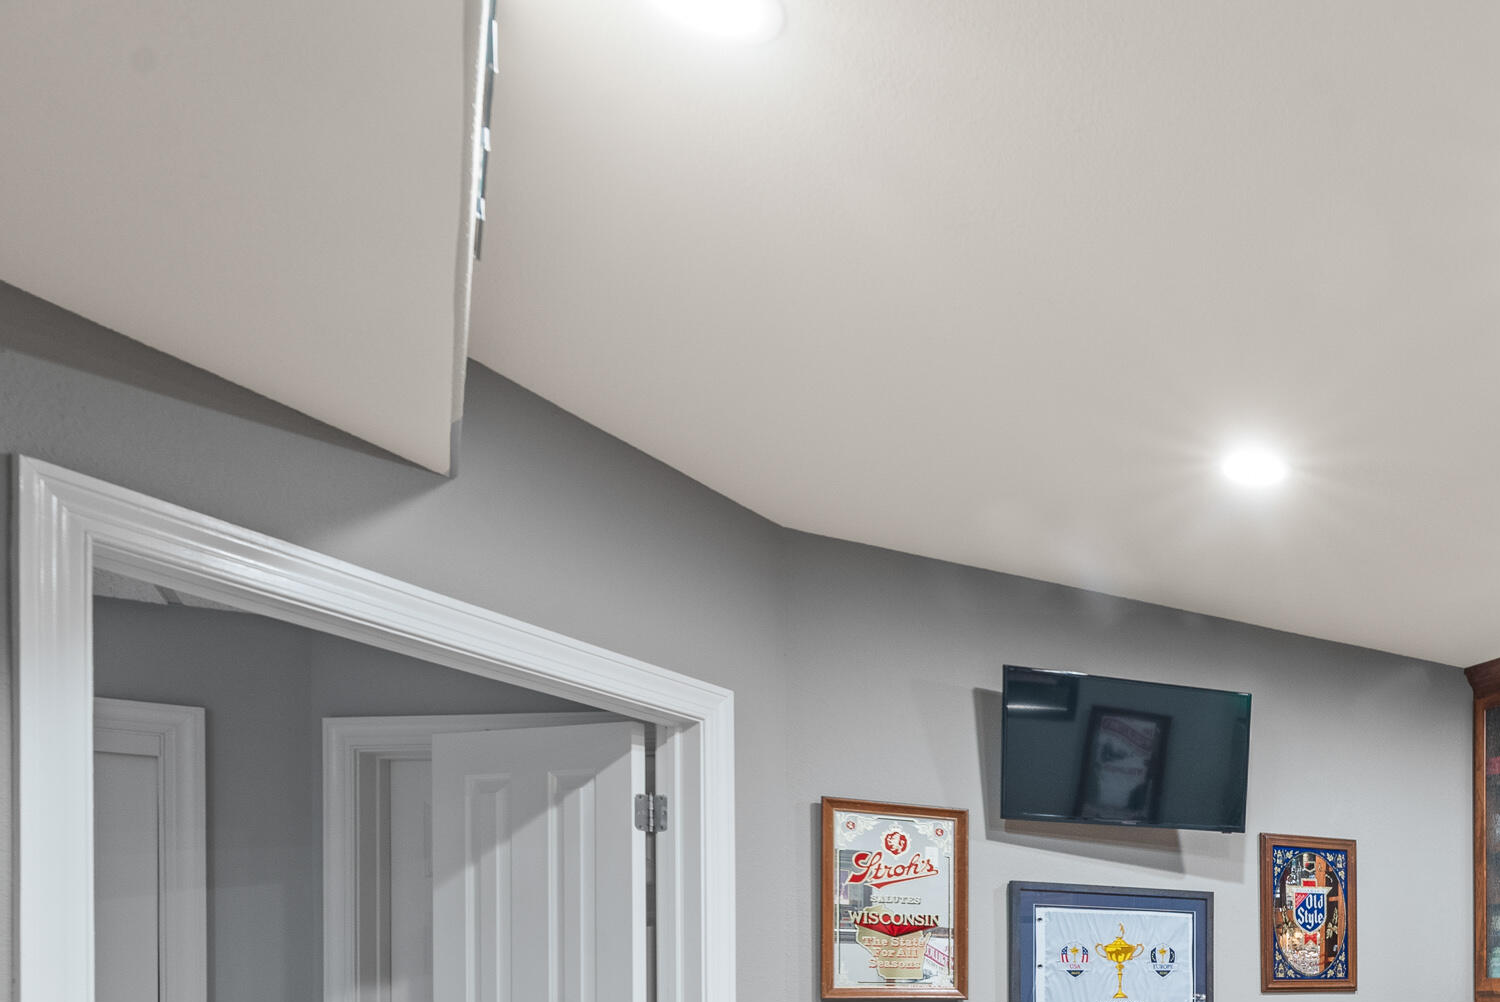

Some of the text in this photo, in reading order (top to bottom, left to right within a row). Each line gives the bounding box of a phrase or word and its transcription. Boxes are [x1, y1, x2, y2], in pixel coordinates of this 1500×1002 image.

[847, 851, 939, 888] Stroh's
[1305, 893, 1324, 910] Old
[848, 910, 941, 927] WISCONSIN
[1297, 906, 1324, 930] Style
[862, 936, 925, 948] The State
[872, 947, 896, 958] For
